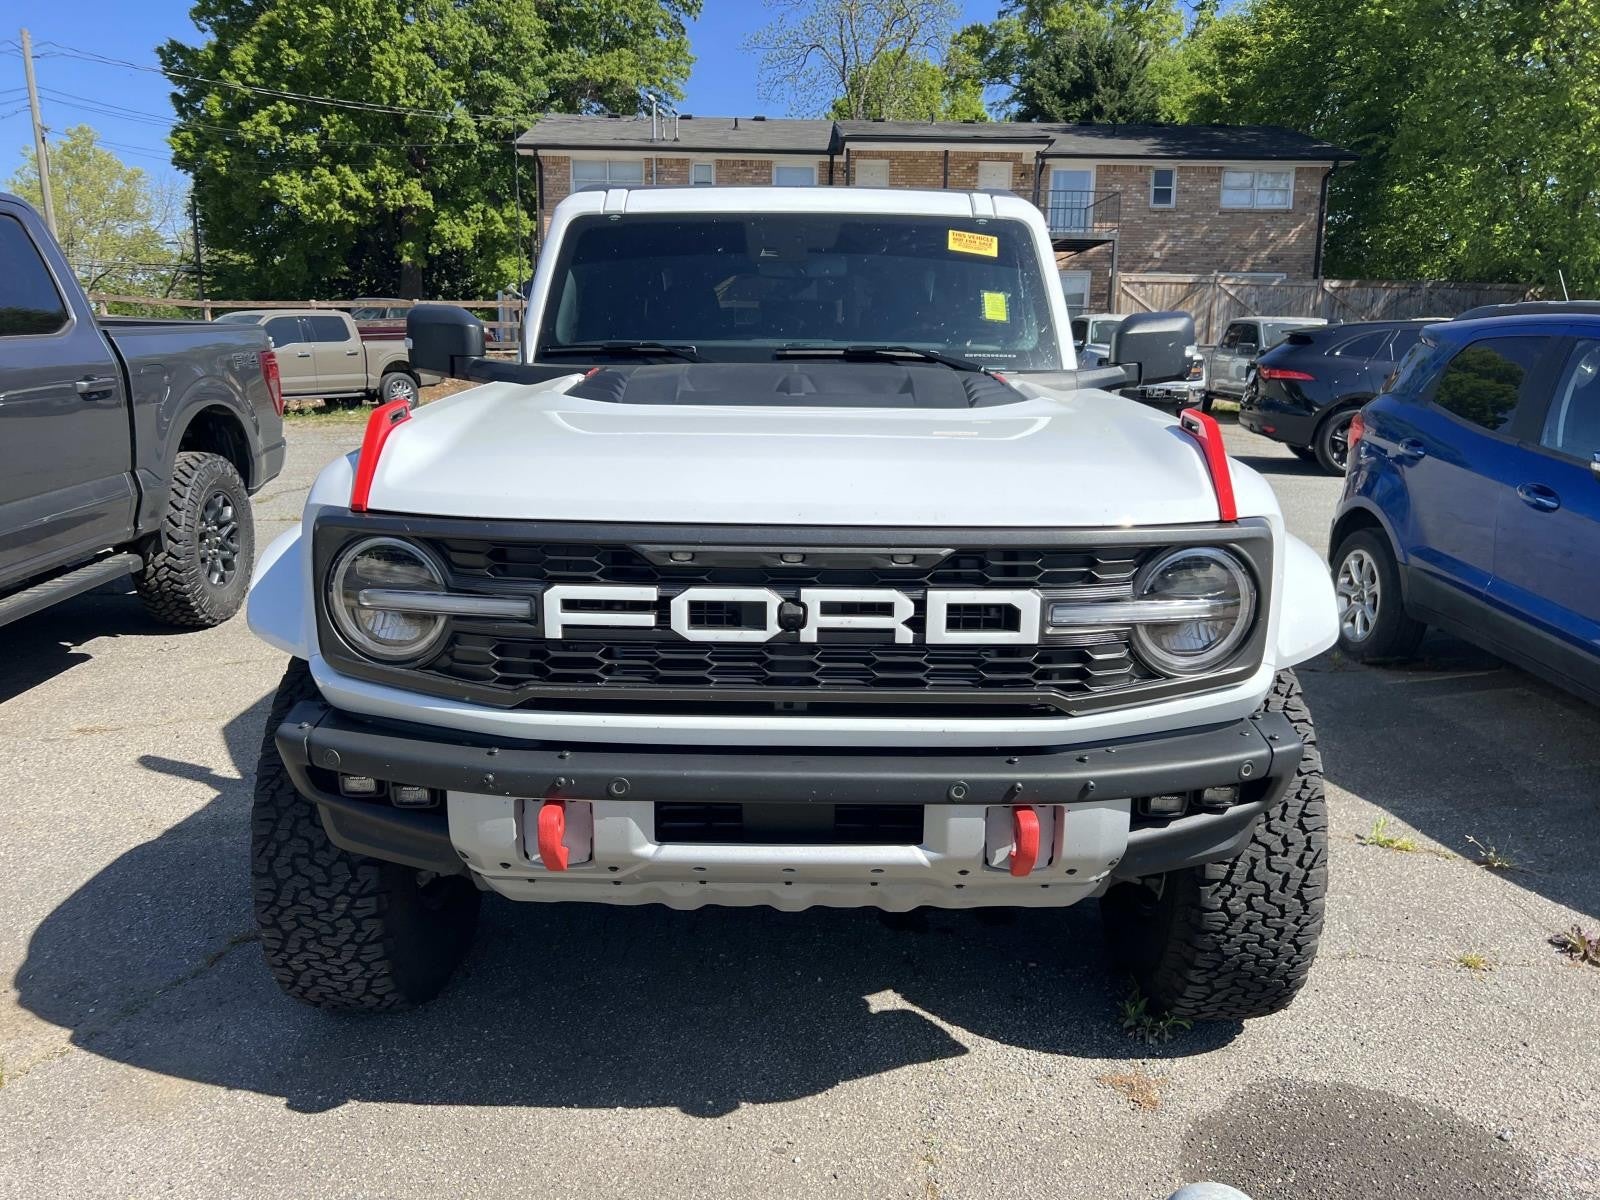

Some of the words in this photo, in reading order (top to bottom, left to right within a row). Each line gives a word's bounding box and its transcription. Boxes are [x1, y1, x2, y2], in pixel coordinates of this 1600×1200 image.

[967, 234, 993, 242] VEHICLE
[232, 352, 260, 369] FX4
[544, 585, 1041, 644] FORD
